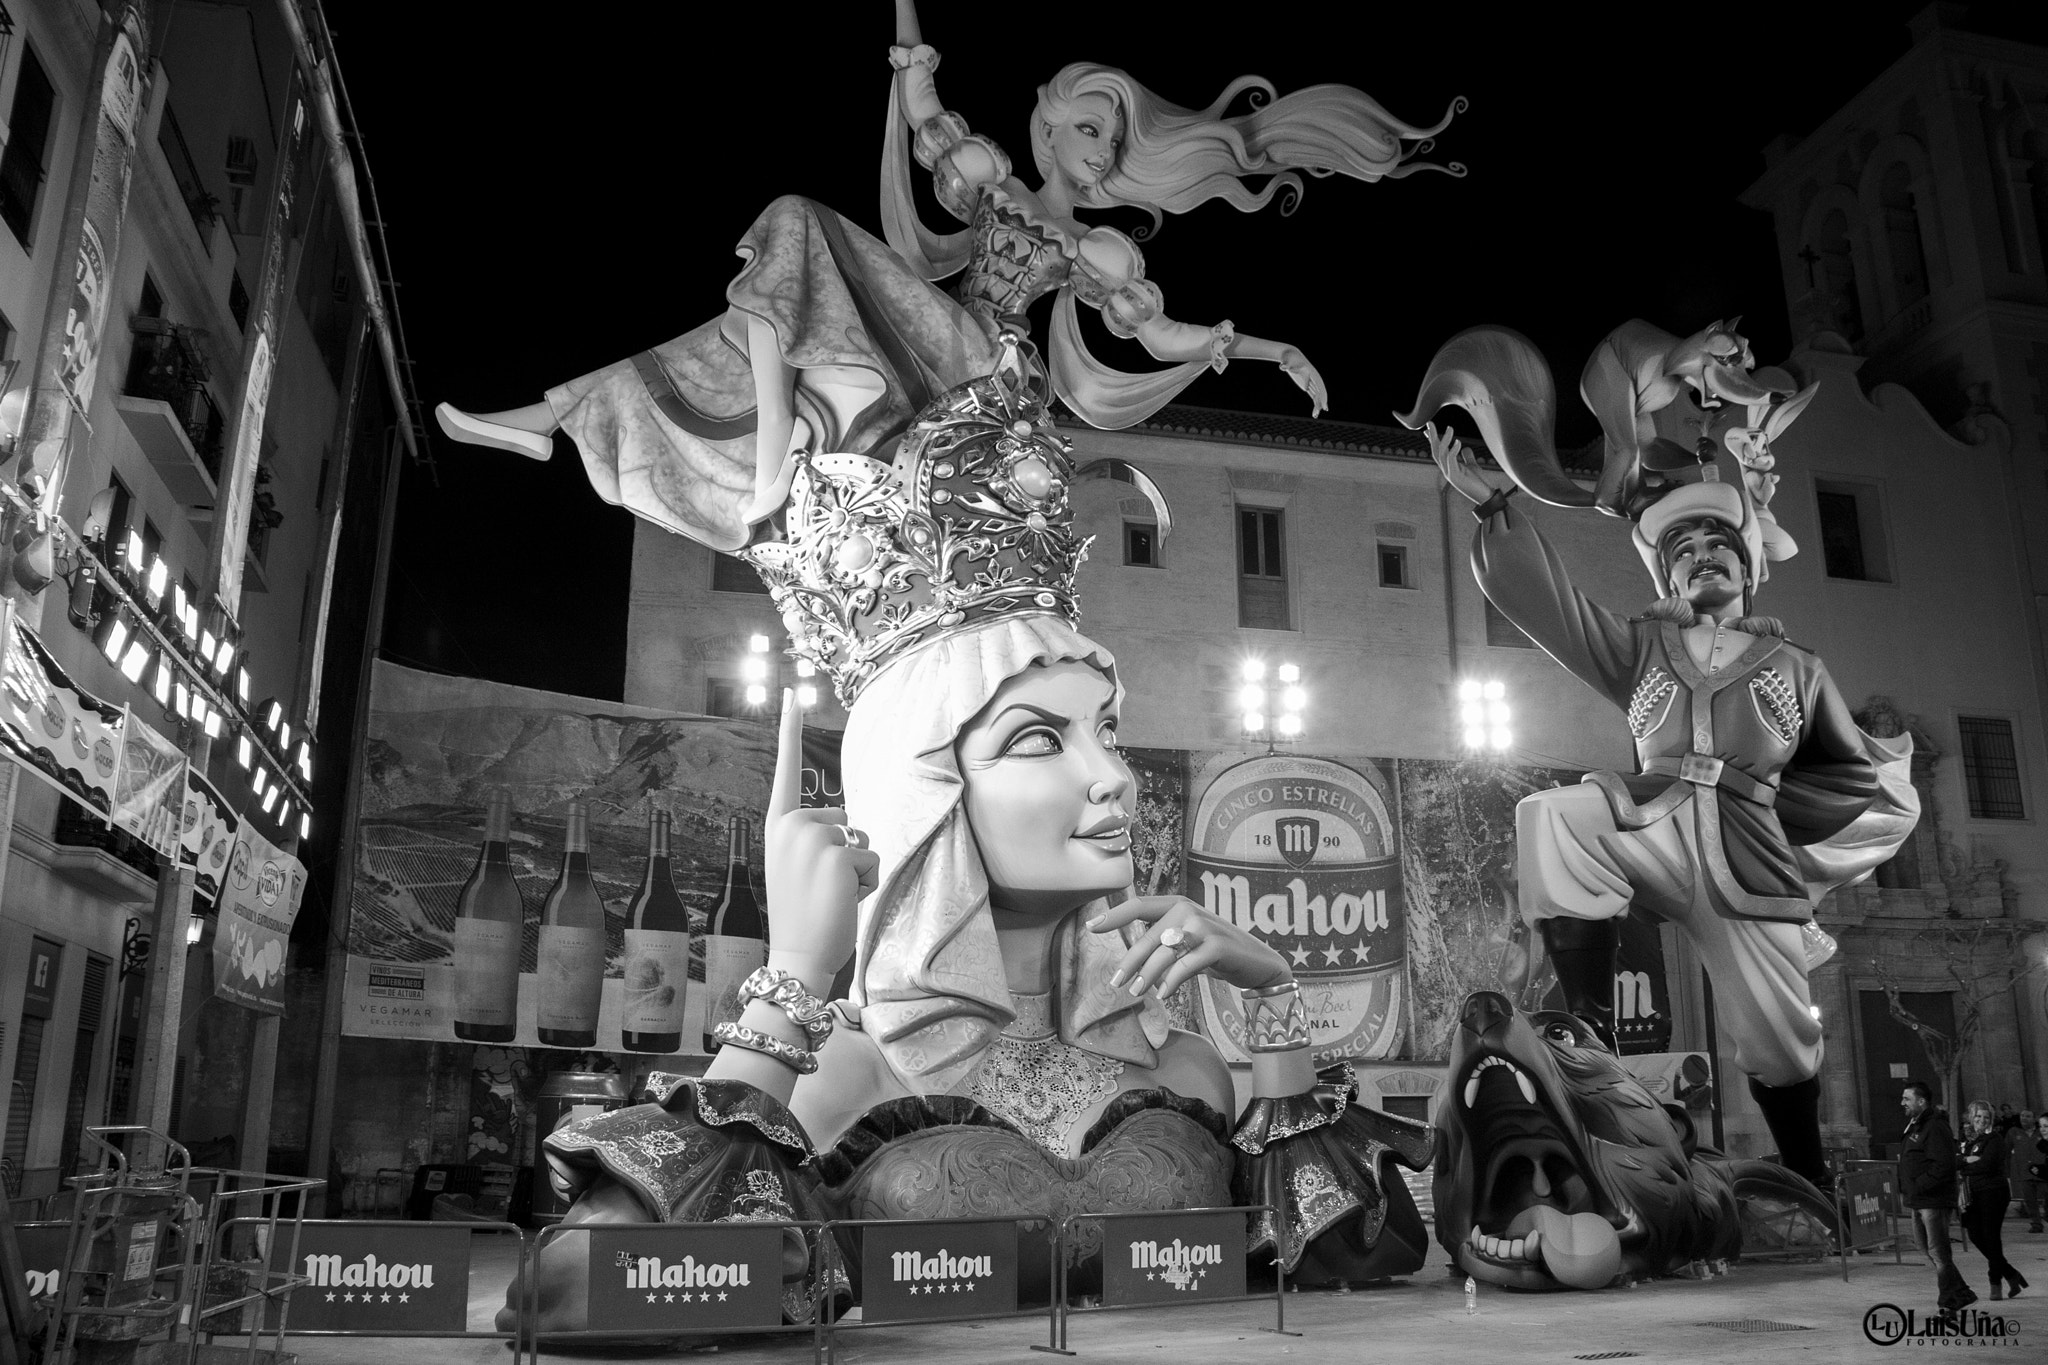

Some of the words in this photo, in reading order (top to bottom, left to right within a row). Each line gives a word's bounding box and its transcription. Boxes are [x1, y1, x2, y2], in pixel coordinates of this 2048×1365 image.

[1217, 787, 1274, 831] CINCO
[1282, 785, 1374, 836] ESTRELLAS
[1254, 834, 1271, 847] 18
[1323, 836, 1340, 848] 90
[1200, 870, 1389, 936] Mahou
[372, 966, 391, 975] VINOS
[387, 989, 395, 997] DE
[397, 990, 421, 999] ALTURA
[360, 1005, 432, 1018] VEGAMAR
[1311, 1012, 1385, 1062] ESPECIAL
[891, 1249, 993, 1282] Mahou
[1129, 1238, 1223, 1269] Mahou
[304, 1253, 434, 1289] Mahou
[626, 1255, 751, 1289] Mahou
